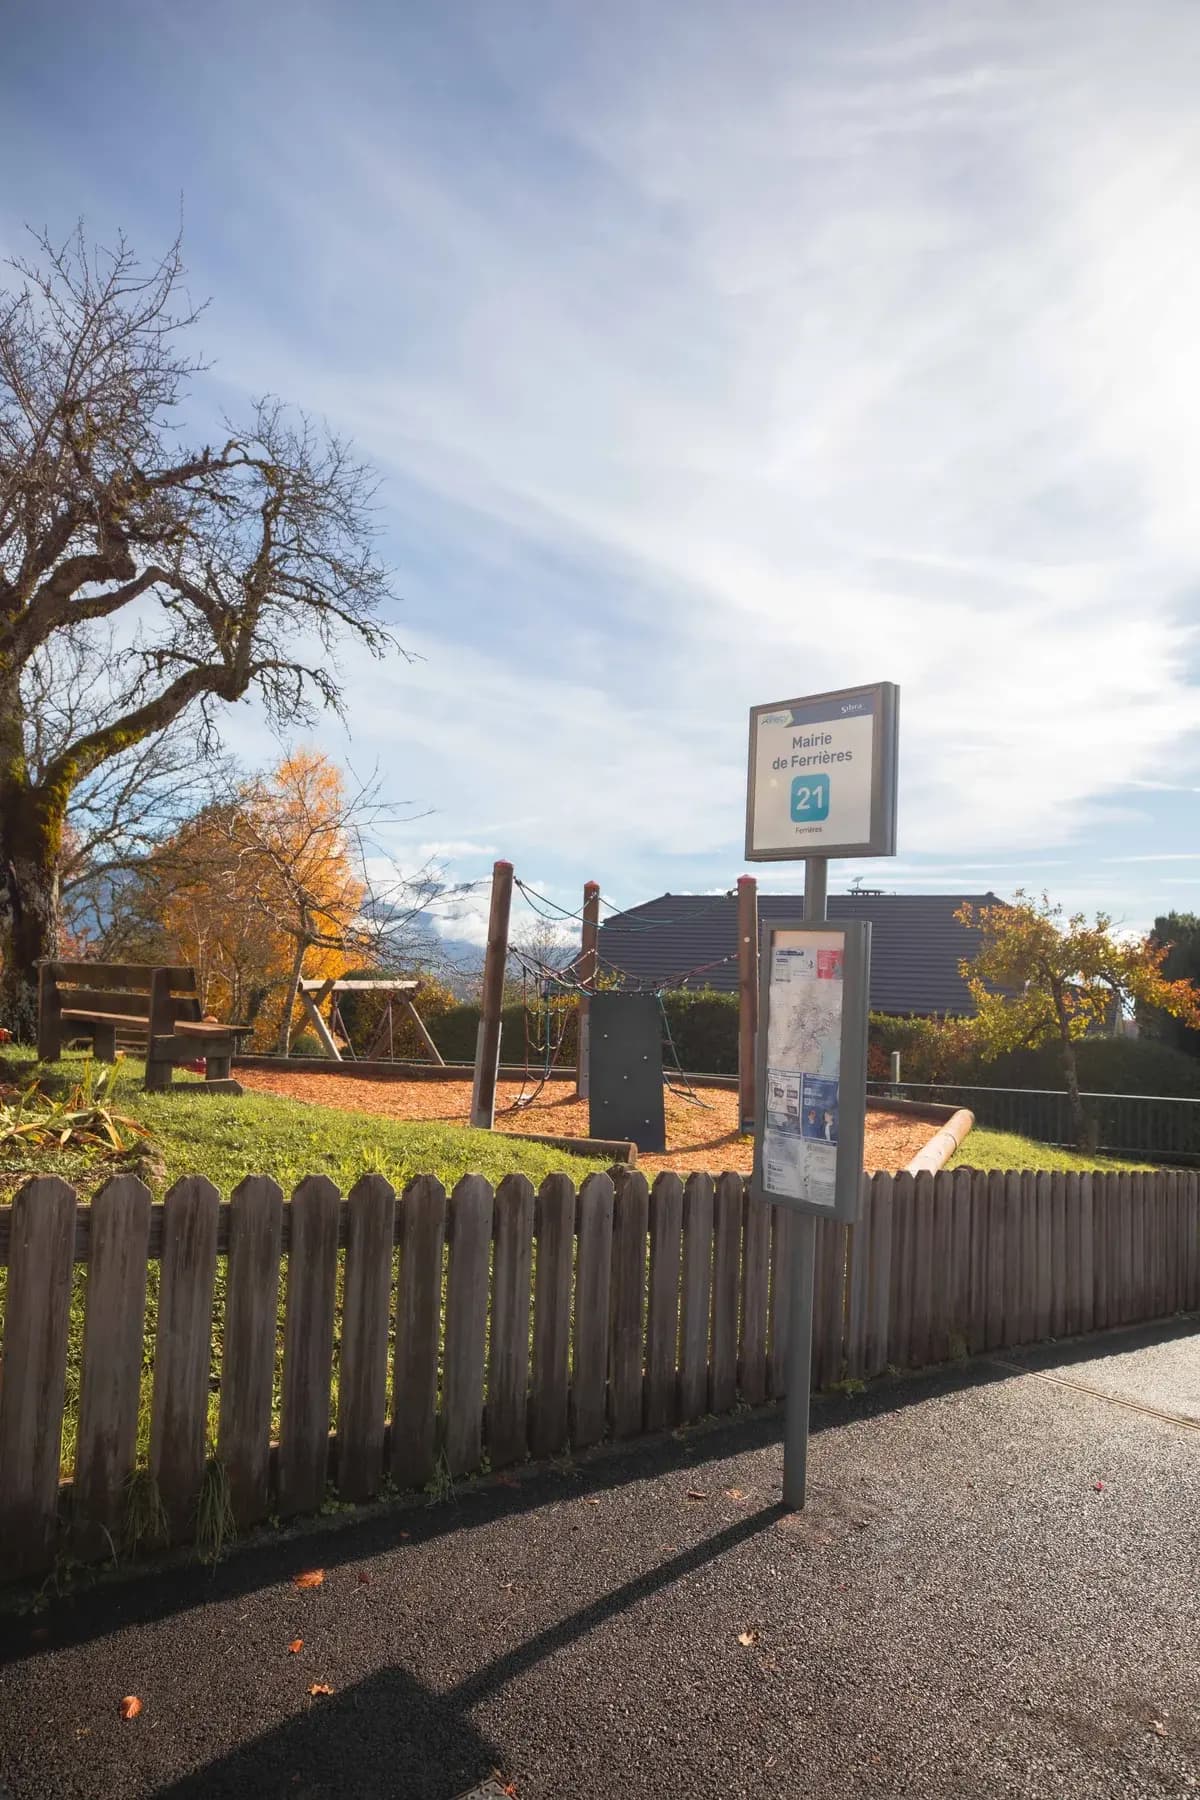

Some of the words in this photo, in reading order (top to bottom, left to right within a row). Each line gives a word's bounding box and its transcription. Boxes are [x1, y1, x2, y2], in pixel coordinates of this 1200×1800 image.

[792, 732, 832, 749] Mairie
[772, 757, 788, 770] de
[791, 750, 853, 768] Ferrières
[796, 785, 824, 810] 21
[795, 826, 823, 835] Ferrières
